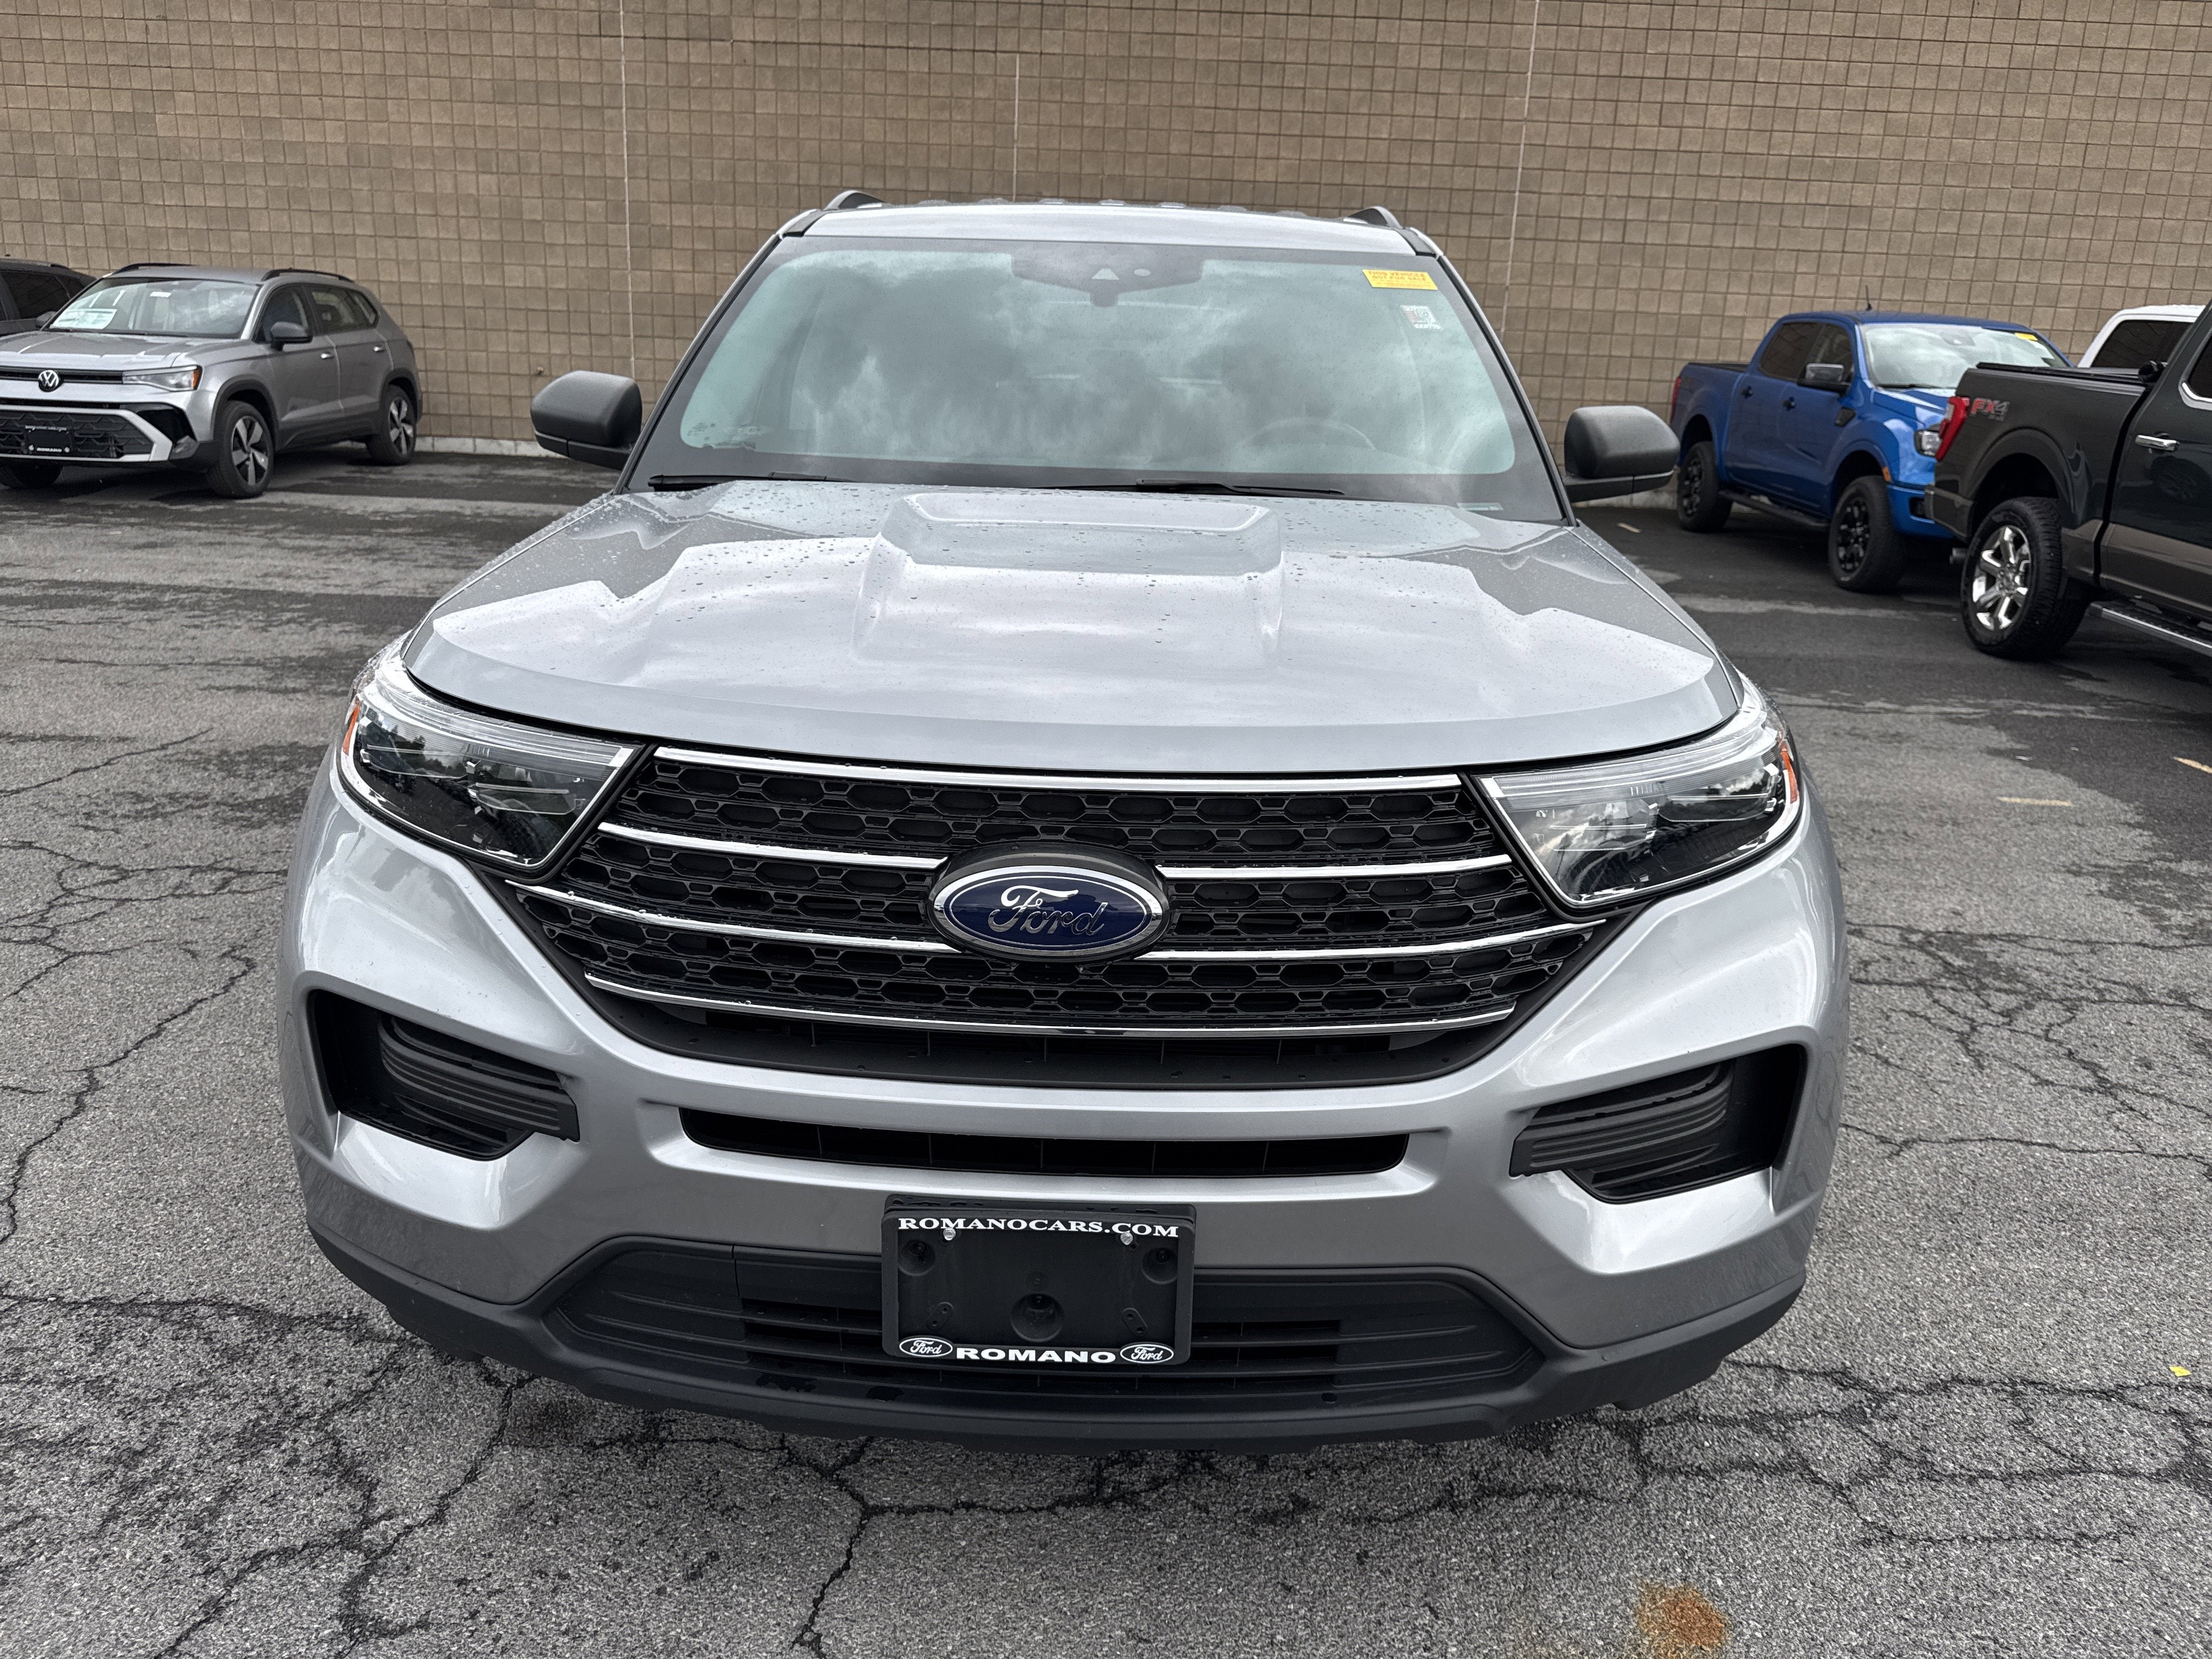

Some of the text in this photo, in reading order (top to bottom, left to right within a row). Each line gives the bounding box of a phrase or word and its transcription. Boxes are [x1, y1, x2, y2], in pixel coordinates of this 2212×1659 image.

[1971, 398, 2010, 416] FX4
[988, 885, 1108, 936] Ford
[898, 1217, 1179, 1238] ROMANOCARS.COM
[910, 1340, 1164, 1363] Ford ROMANO Ford
